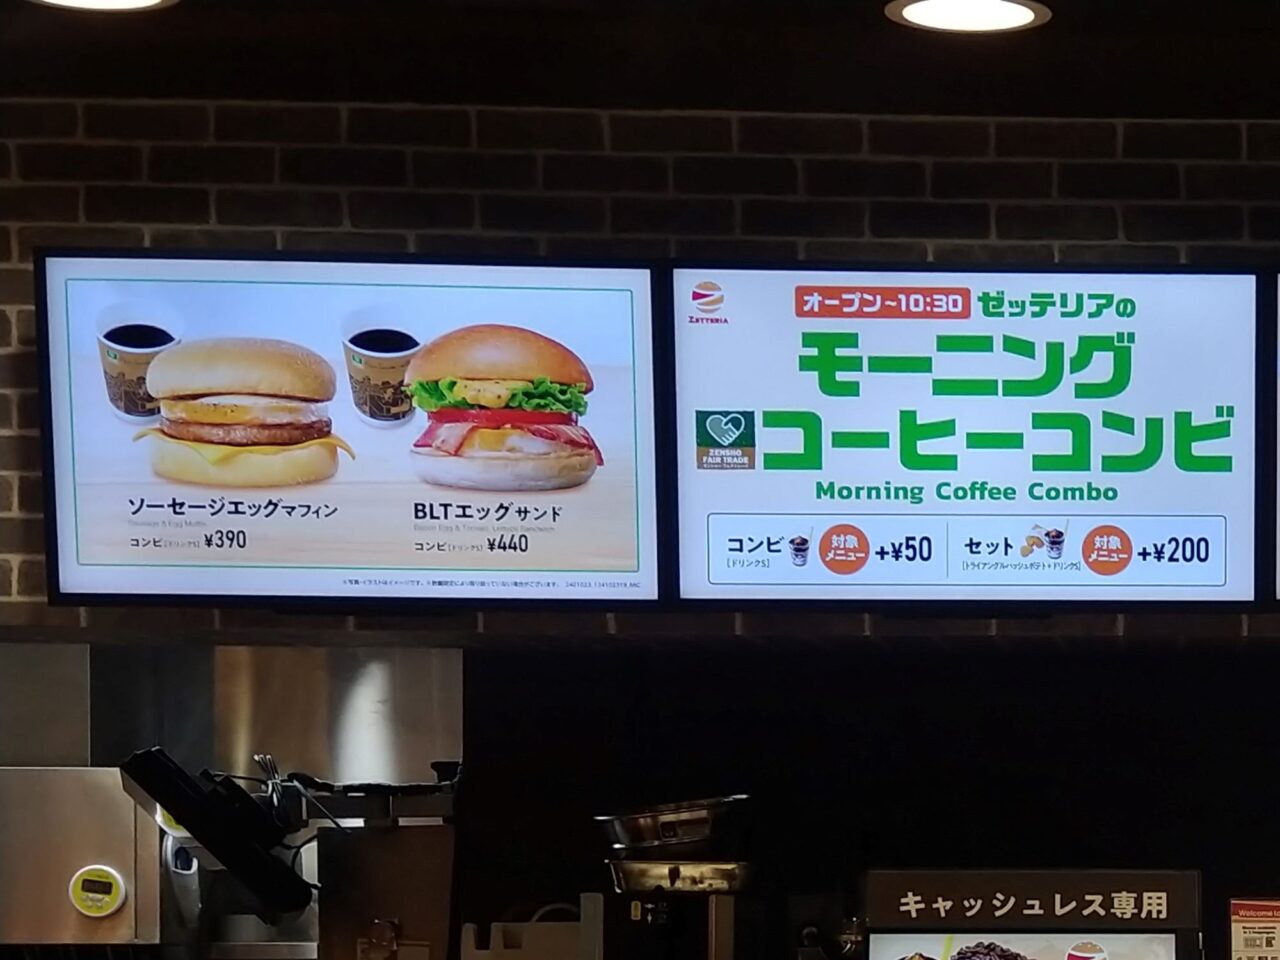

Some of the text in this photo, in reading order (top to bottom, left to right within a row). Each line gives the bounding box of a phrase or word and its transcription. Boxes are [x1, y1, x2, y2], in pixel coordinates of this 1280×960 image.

[977, 290, 1136, 318] ゼッテリアの
[687, 315, 729, 324] ZETTERIA
[798, 331, 1136, 399] モーニング
[762, 404, 1235, 473] コーヒーコンビ
[815, 480, 1119, 504] Morning Coffee Combo
[128, 496, 339, 519] ソーセージエッグマフィン
[413, 501, 563, 523] BLTエッグサンド
[203, 529, 247, 549] ¥390
[487, 533, 529, 553] ¥440
[727, 535, 785, 554] コンビ
[831, 533, 859, 549] 対象
[875, 535, 933, 562] +¥50
[964, 536, 1013, 557] セット
[1094, 535, 1122, 550] 対象
[1137, 536, 1210, 563] +¥200
[825, 550, 866, 562] メニュー
[1089, 551, 1129, 563] メニュー
[899, 891, 1169, 919] キャッシュレス専用
